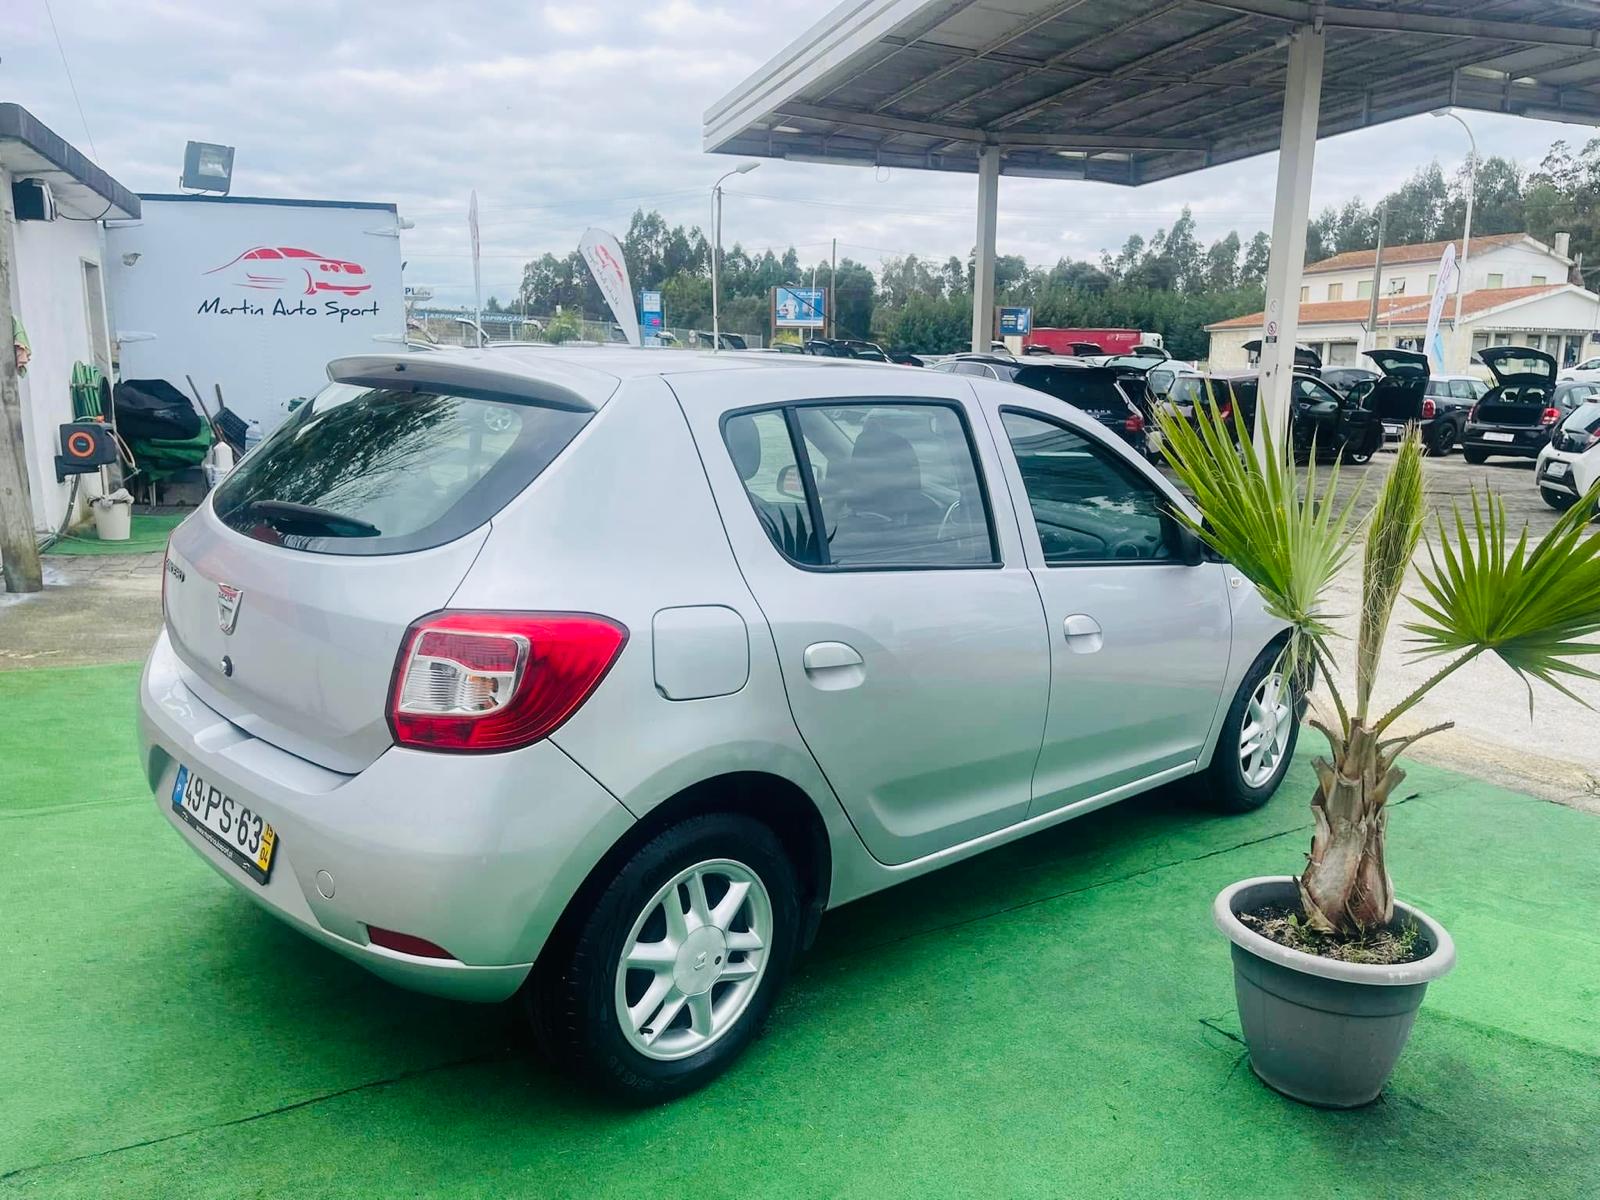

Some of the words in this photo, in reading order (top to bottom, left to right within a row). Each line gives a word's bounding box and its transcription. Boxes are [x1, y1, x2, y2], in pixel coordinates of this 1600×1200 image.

[197, 297, 264, 315] Martin
[272, 298, 317, 316] Auto
[324, 300, 380, 323] Sport
